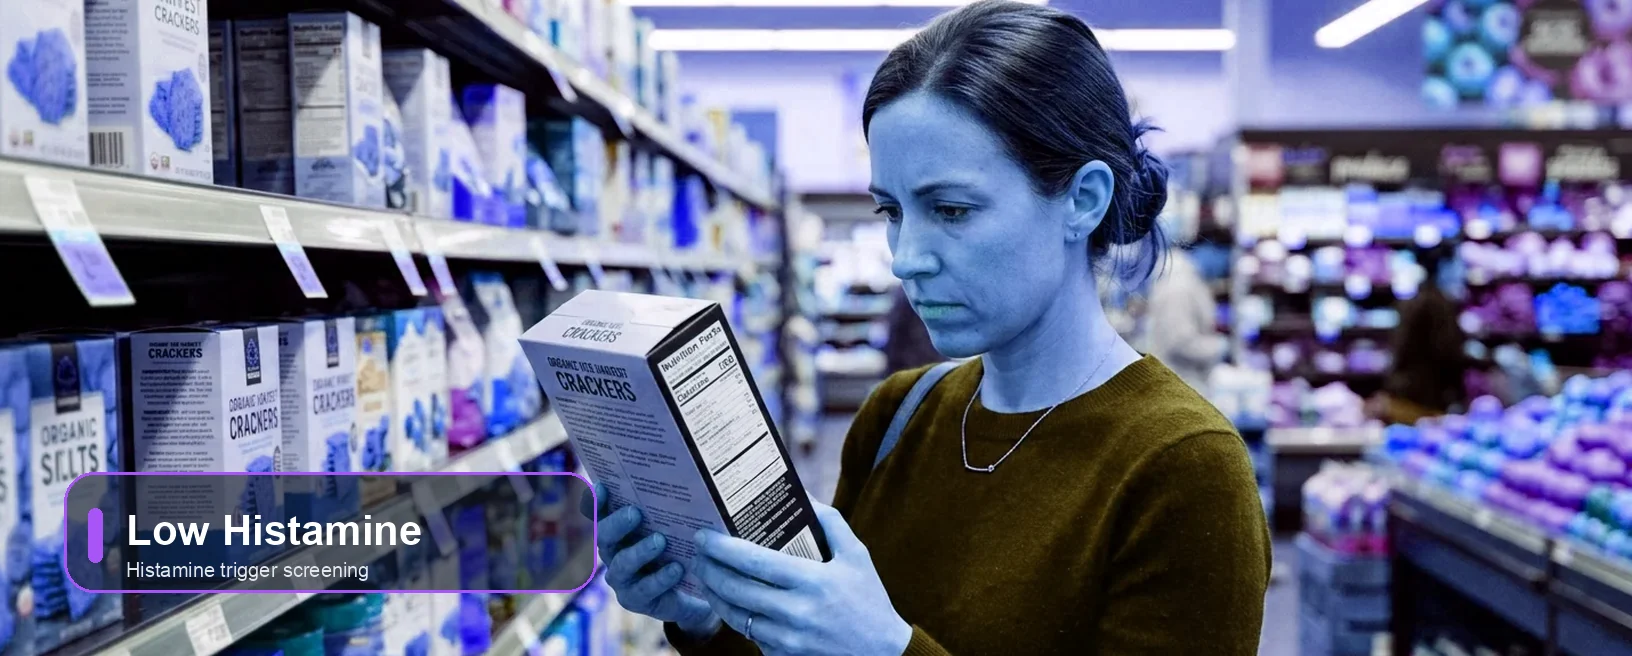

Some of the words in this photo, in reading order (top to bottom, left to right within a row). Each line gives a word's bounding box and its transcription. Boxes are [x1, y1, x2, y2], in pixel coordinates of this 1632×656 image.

[154, 5, 200, 35] CRACKERS
[148, 347, 203, 359] CRACKERS
[555, 370, 637, 402] CRACKERS
[41, 417, 97, 446] ORGANIC
